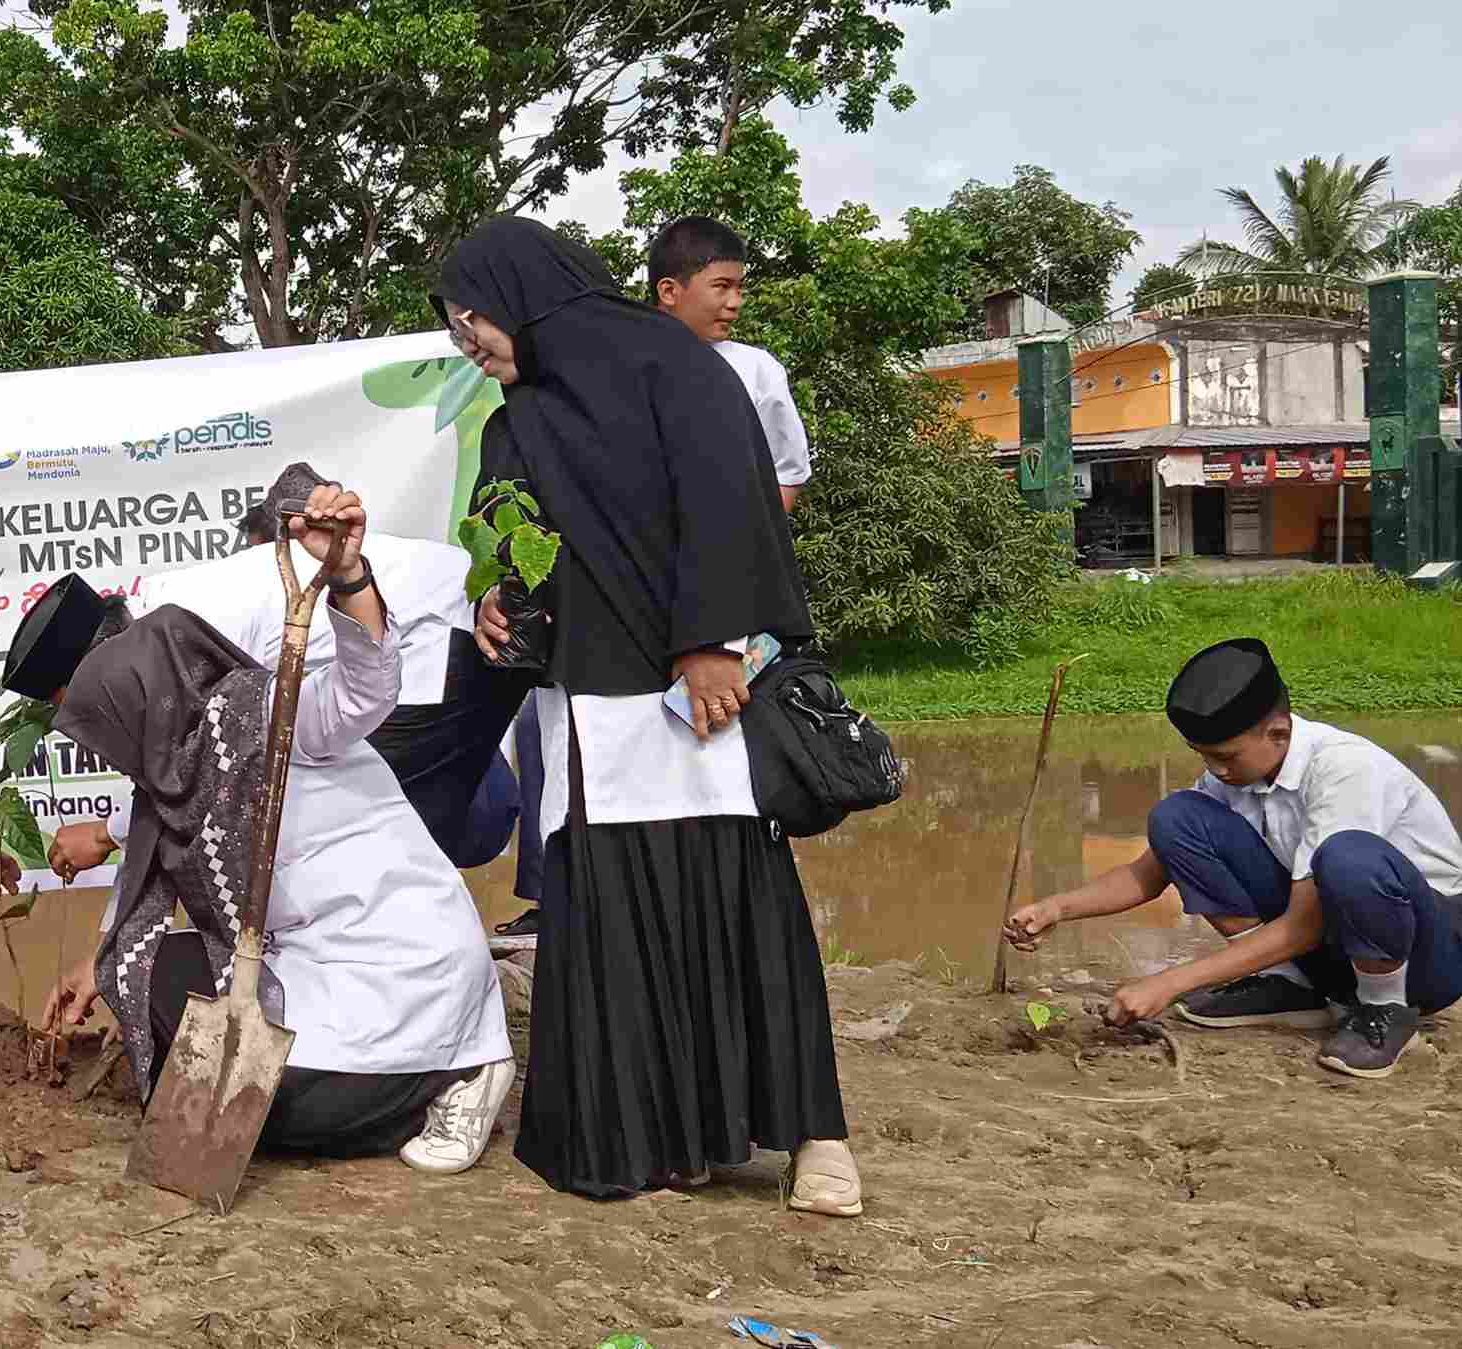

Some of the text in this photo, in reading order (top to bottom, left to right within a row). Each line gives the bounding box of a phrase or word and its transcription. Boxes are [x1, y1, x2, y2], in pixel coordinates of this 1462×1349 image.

[1233, 284, 1261, 303] 721
[174, 411, 272, 453] pendis
[26, 444, 111, 460] Madrasah Maju,
[28, 467, 80, 480] Mendunia
[221, 486, 266, 520] BE
[18, 526, 255, 574] MTsN PINRA
[24, 795, 121, 819] inrang.
